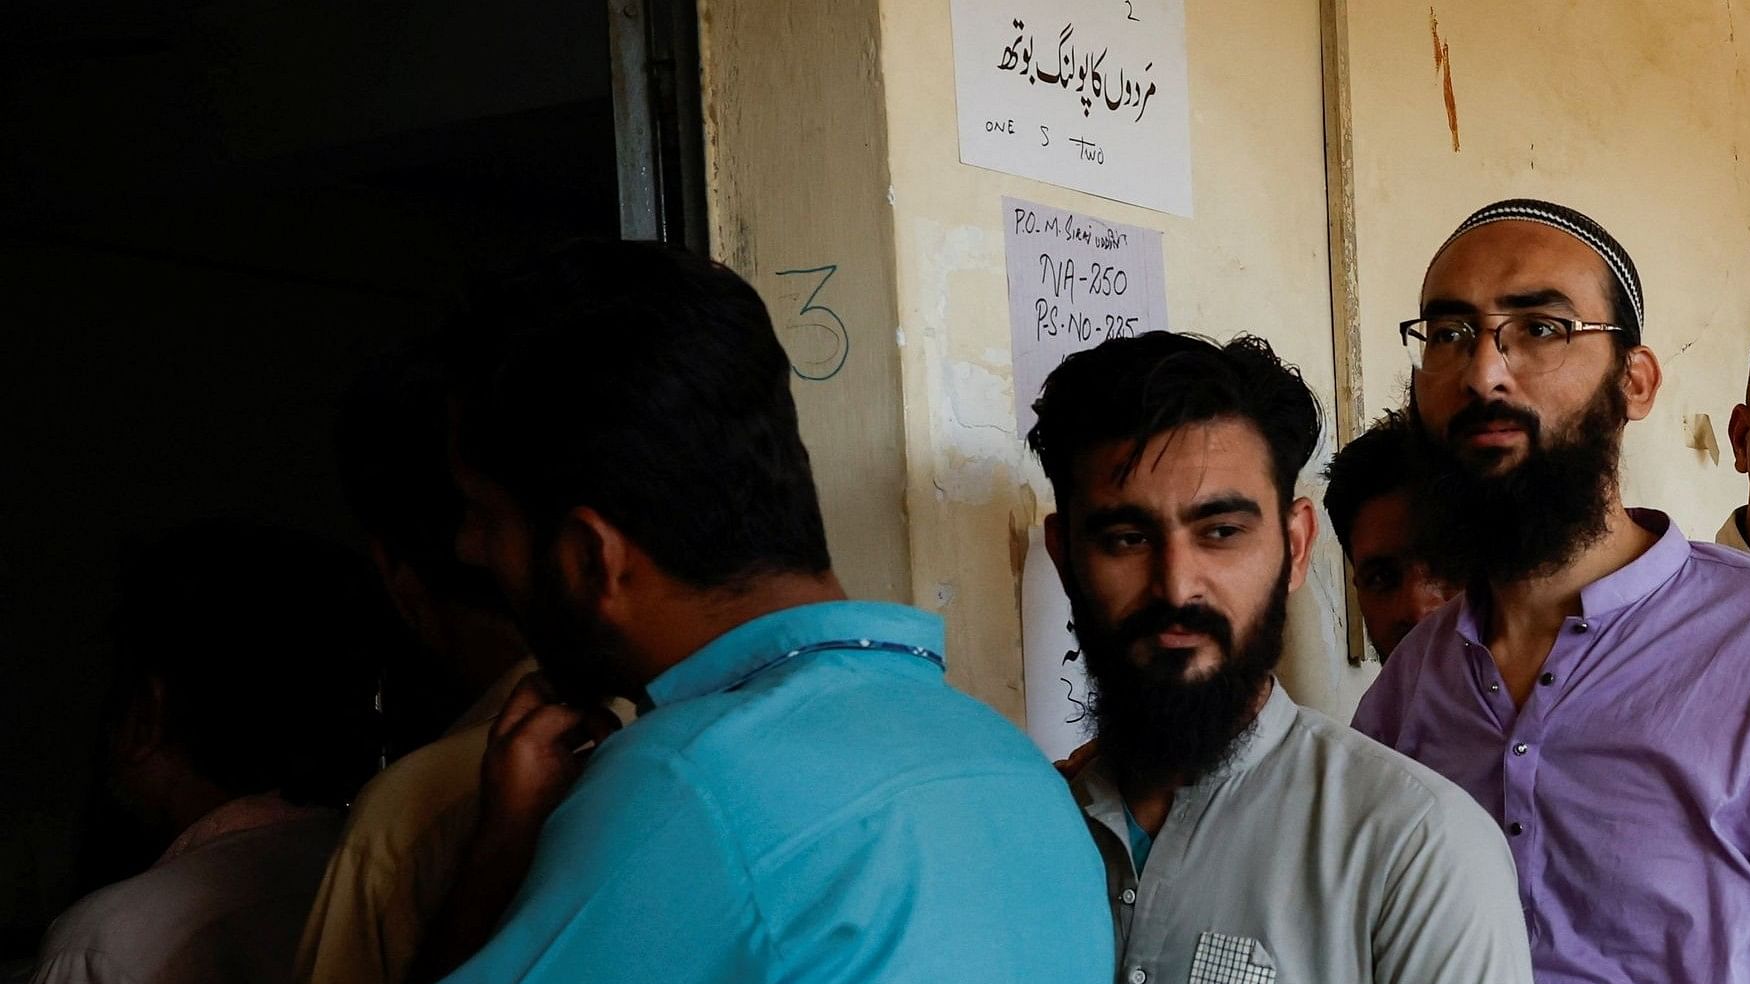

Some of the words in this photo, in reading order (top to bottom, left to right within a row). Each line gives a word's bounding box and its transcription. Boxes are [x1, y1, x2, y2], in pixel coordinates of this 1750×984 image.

[985, 119, 1016, 135] ONE
[1039, 253, 1128, 304] NA-250
[775, 264, 849, 381] 3
